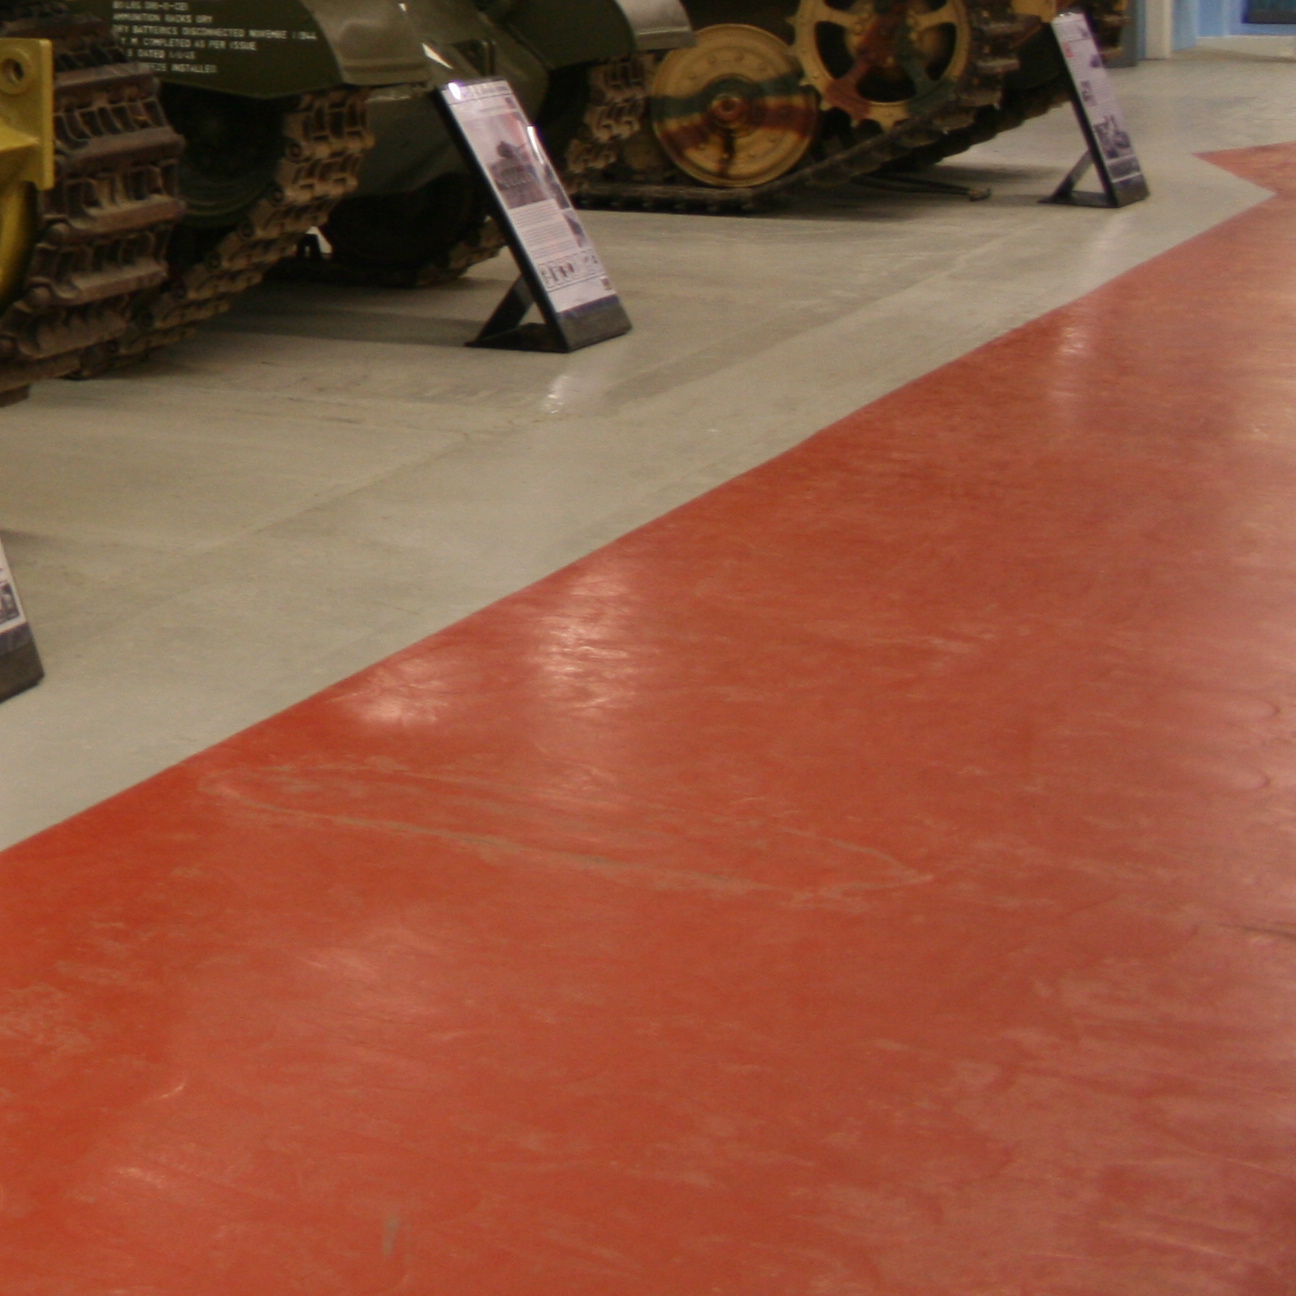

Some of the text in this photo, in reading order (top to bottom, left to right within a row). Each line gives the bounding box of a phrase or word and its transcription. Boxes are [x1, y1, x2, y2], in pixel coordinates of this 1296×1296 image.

[181, 27, 246, 38] DISCONNECTED
[142, 37, 192, 48] COMPLETED
[136, 49, 166, 59] DATED
[170, 63, 218, 74] INSTALLED
